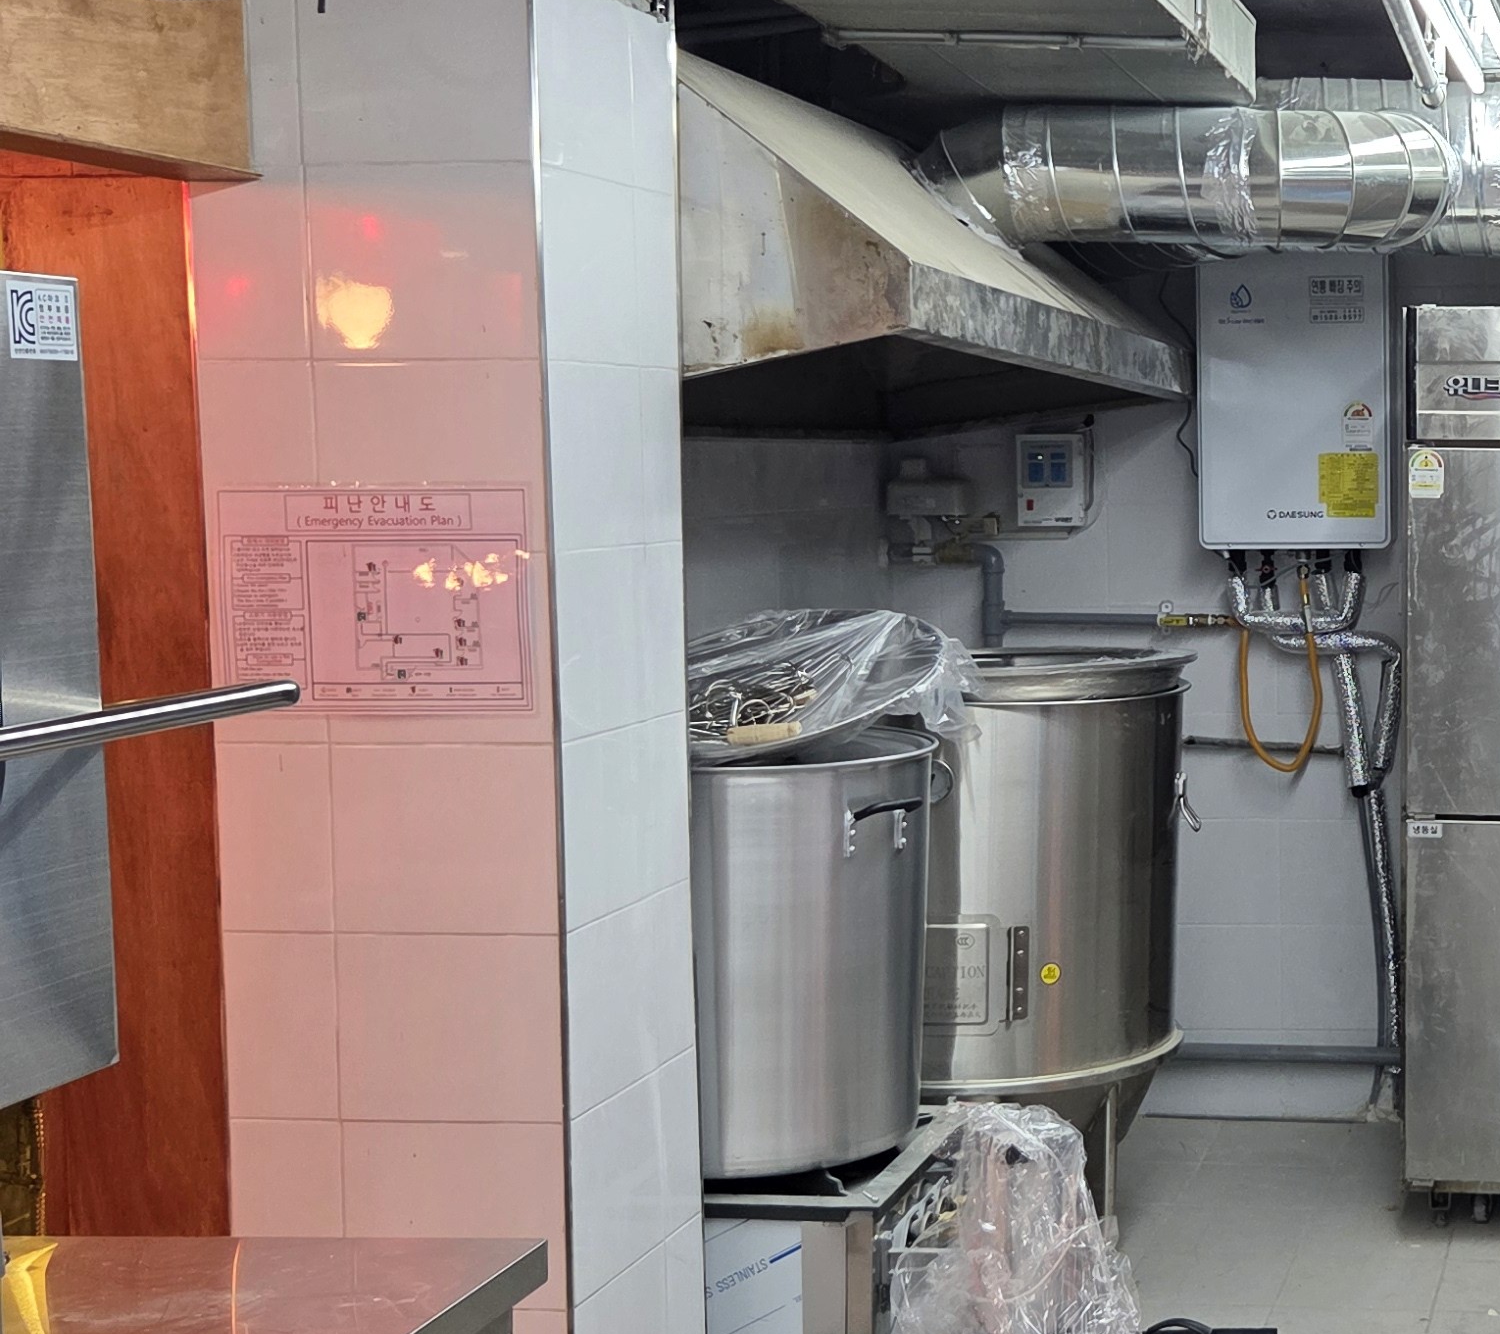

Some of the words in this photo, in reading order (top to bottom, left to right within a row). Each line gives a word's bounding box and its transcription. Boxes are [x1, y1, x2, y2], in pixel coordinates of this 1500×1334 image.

[1278, 510, 1324, 519] DAESUNG
[305, 516, 364, 529] Emergency
[368, 516, 427, 526] Evacuation
[431, 516, 454, 526] Plan
[715, 1258, 768, 1293] STAINLESS
